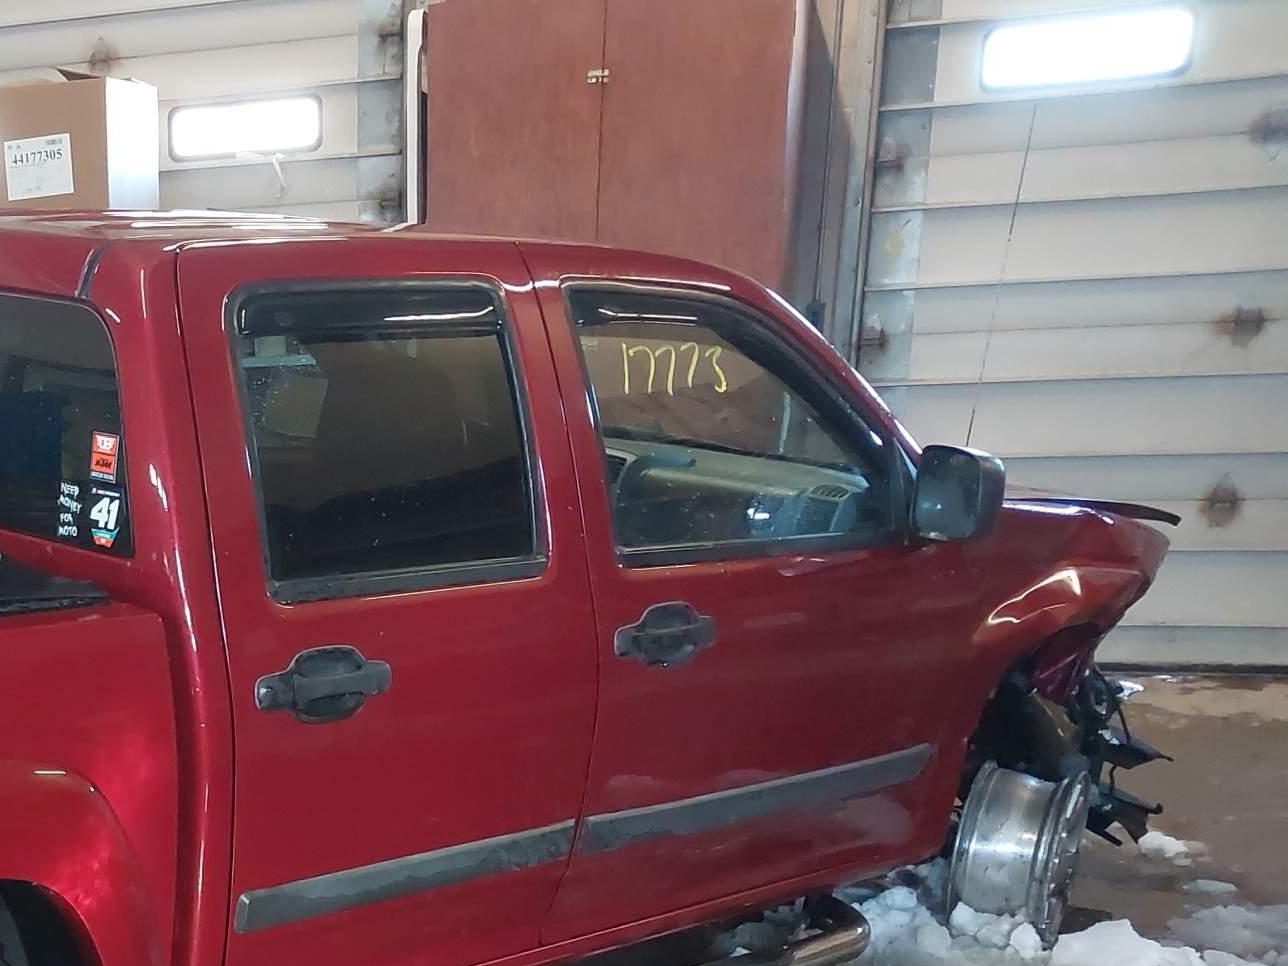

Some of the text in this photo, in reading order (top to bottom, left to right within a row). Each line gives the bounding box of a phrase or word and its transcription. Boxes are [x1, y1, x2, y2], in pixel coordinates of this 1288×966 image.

[11, 148, 63, 166] 44177305
[621, 342, 728, 395] 17773
[89, 496, 120, 530] 41
